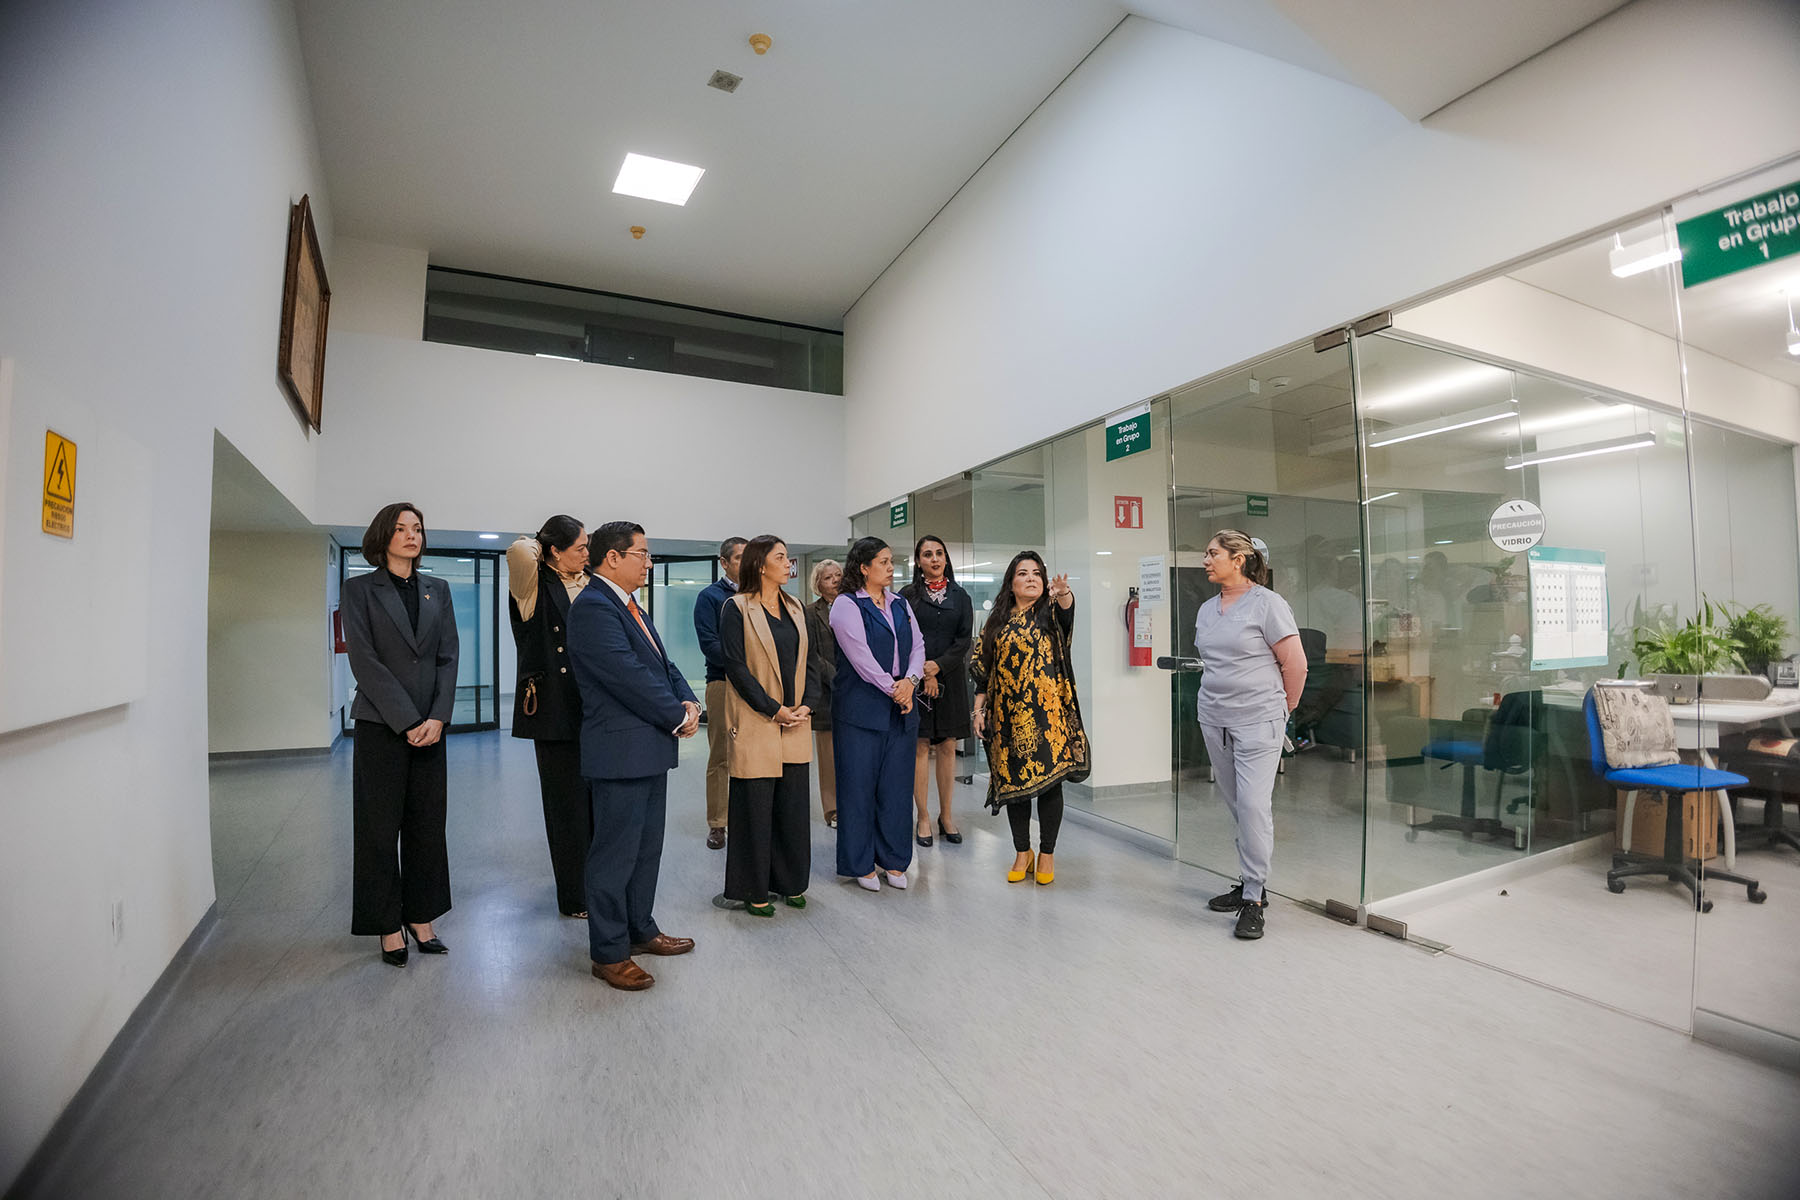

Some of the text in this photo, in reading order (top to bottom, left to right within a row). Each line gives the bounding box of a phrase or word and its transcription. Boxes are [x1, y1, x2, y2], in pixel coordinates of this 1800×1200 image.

[1723, 192, 1799, 227] Trabajo
[1718, 232, 1743, 251] en
[1759, 241, 1769, 259] 1
[1118, 422, 1138, 434] Trabajo
[1116, 432, 1140, 445] en Grupo
[1126, 444, 1130, 452] 2
[1502, 537, 1532, 546] VIDRIO
